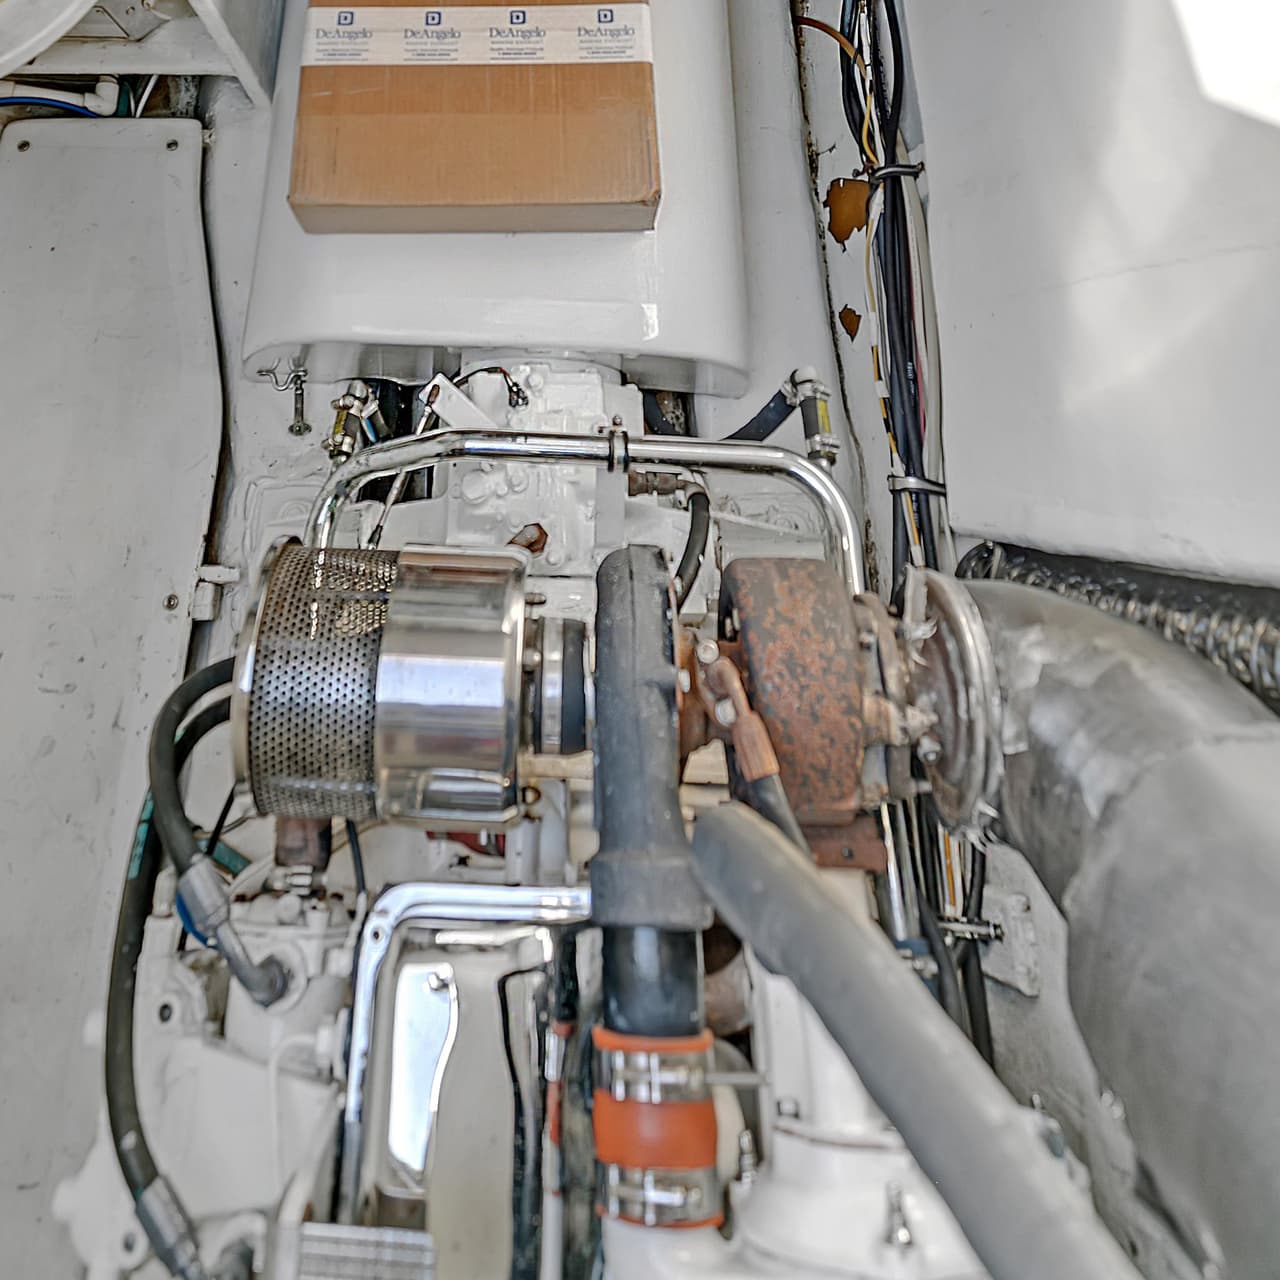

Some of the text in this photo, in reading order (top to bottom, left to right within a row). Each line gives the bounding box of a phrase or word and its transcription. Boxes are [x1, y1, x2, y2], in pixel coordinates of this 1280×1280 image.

[315, 27, 373, 41] DeAngelo
[403, 27, 462, 41] DeAngelo
[489, 26, 546, 40] DeAngelo
[577, 24, 635, 38] DeAngelo
